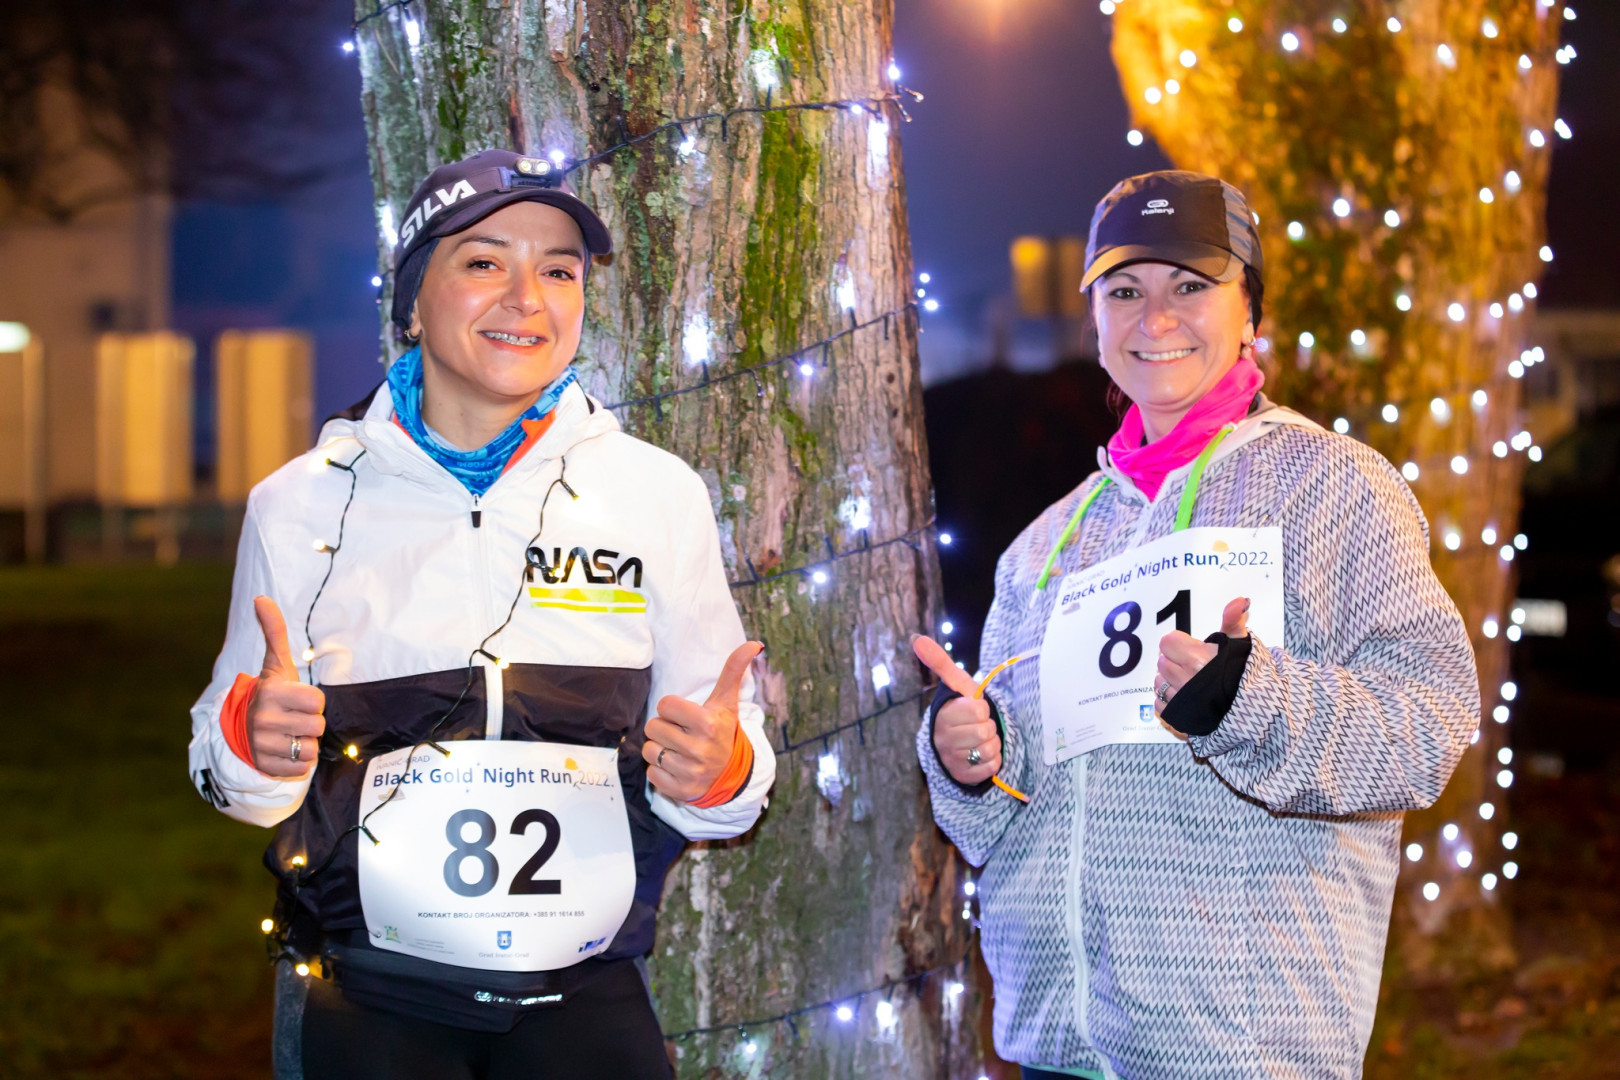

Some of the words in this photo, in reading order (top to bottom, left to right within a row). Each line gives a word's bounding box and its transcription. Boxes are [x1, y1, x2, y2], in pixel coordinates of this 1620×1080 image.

[401, 179, 477, 249] SILVA
[526, 547, 643, 588] NASA
[1061, 583, 1097, 606] Black
[1100, 570, 1132, 591] Gold
[1136, 556, 1178, 579] Night
[1184, 552, 1219, 567] Run
[1228, 551, 1274, 567] 2022.
[1098, 589, 1192, 679] 81
[1078, 694, 1103, 706] KONTAKT
[1103, 691, 1120, 700] BROJ
[373, 769, 423, 787] Black
[429, 767, 473, 784] Gold
[483, 767, 535, 788] Night
[540, 768, 573, 784] Run
[578, 770, 615, 788] 2022.
[443, 808, 562, 898] 82
